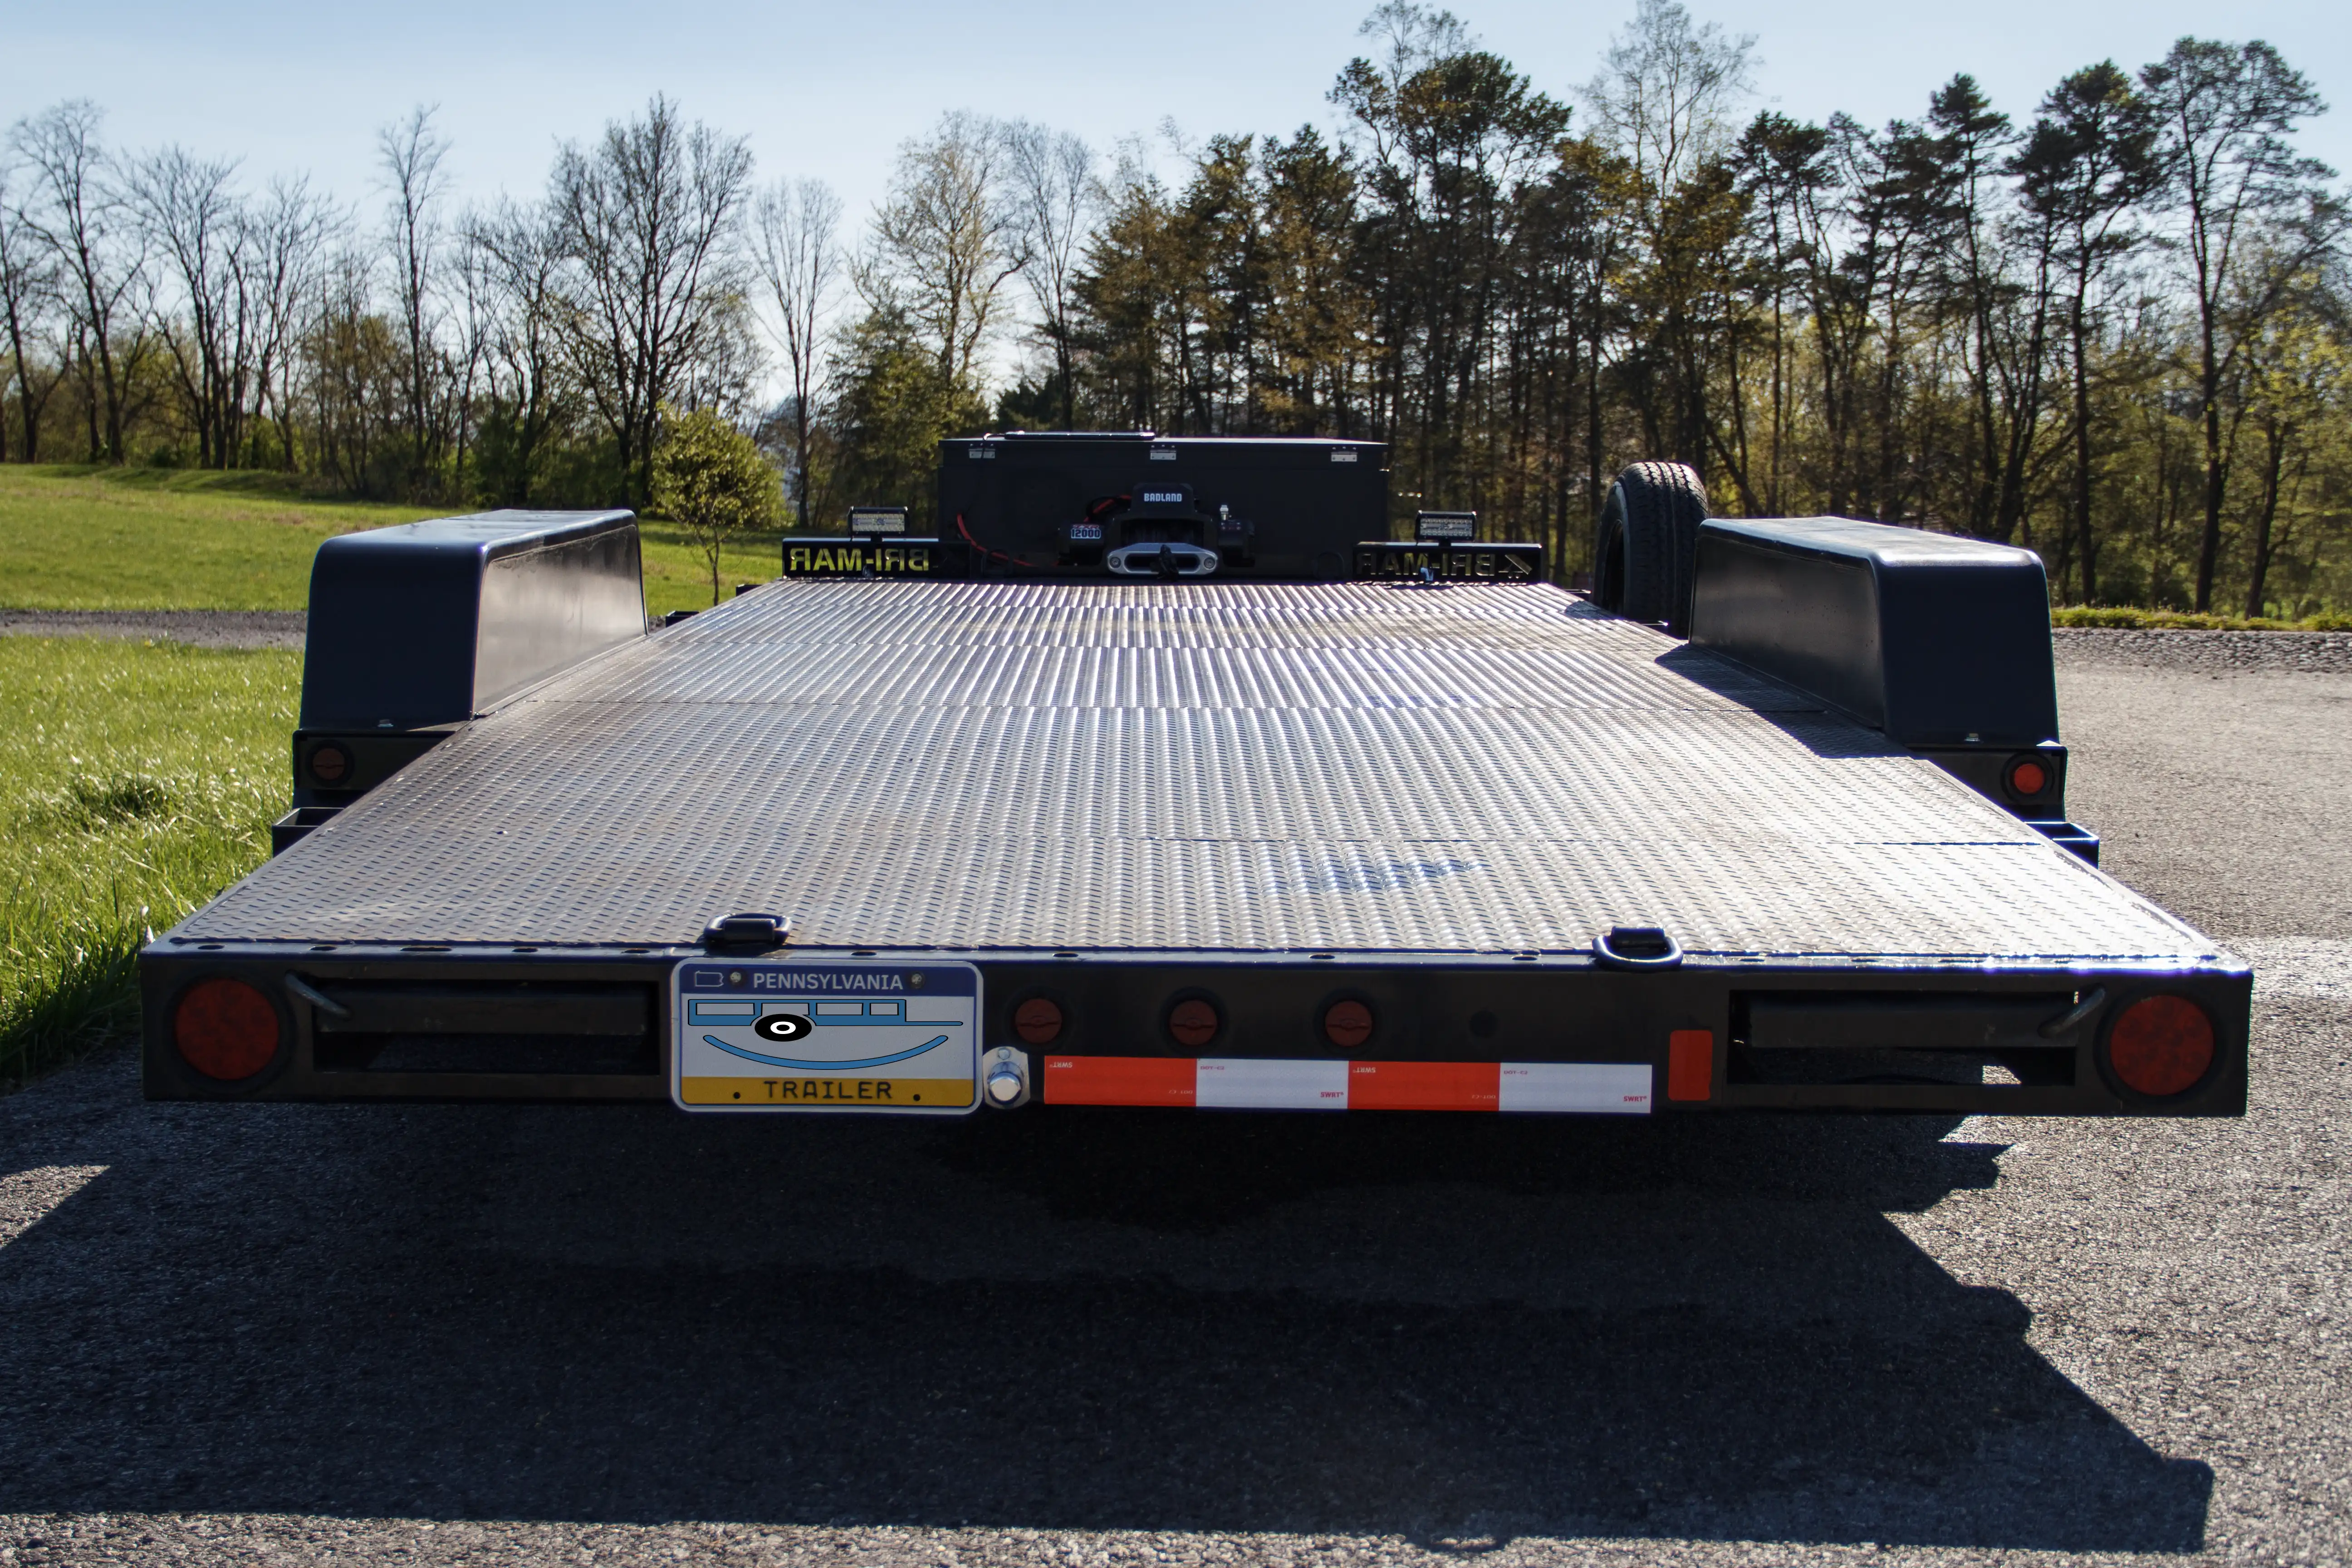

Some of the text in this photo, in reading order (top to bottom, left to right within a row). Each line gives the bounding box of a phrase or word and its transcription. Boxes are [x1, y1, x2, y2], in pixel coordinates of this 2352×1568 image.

[1144, 493, 1182, 502] BADLAND
[1071, 528, 1101, 539] 12000
[753, 973, 903, 990] PENNSYLVANIA
[763, 1081, 892, 1099] TRAILER
